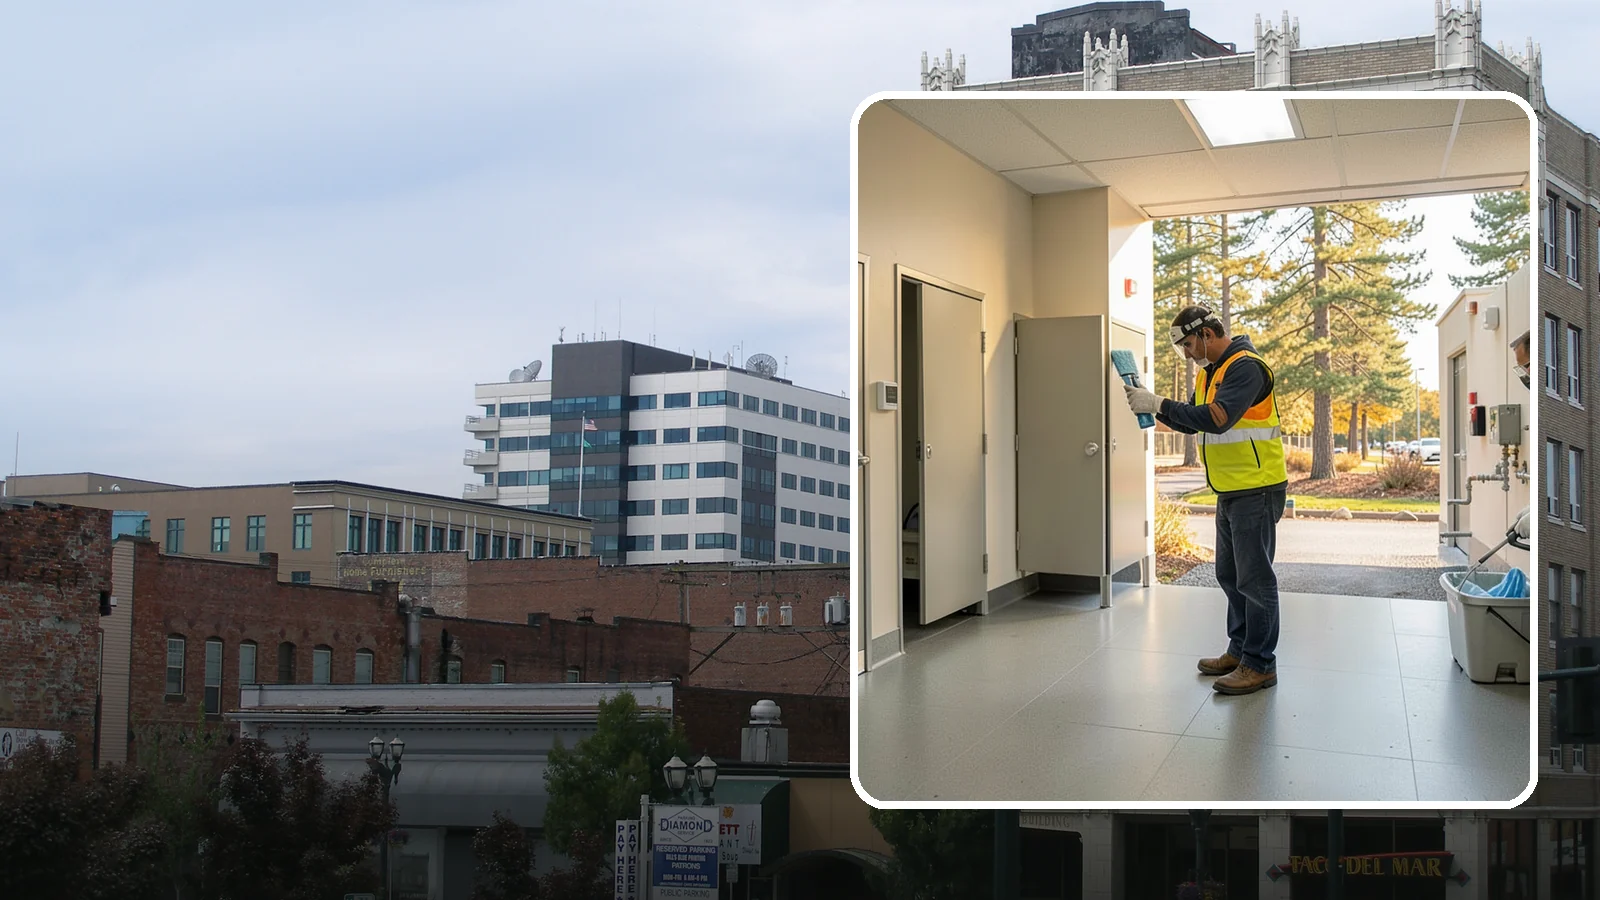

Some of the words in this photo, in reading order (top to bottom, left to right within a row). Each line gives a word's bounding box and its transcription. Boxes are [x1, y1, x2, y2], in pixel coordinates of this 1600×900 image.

[370, 566, 427, 577] Furnishers
[660, 818, 713, 832] DIAMOND
[1022, 815, 1070, 828] BUILDING
[617, 825, 625, 852] PAY
[628, 824, 637, 851] PAY
[656, 845, 687, 853] RESERVED
[689, 846, 716, 854] PARKING
[721, 851, 739, 861] Soup
[671, 862, 701, 870] PATRONS
[1289, 855, 1329, 874] TAC
[1346, 856, 1385, 875] DEL
[1392, 857, 1442, 876] MAR
[616, 856, 625, 893] HERE
[627, 856, 637, 893] HERE
[660, 888, 682, 897] PUBLIC
[683, 889, 710, 899] PARKING
